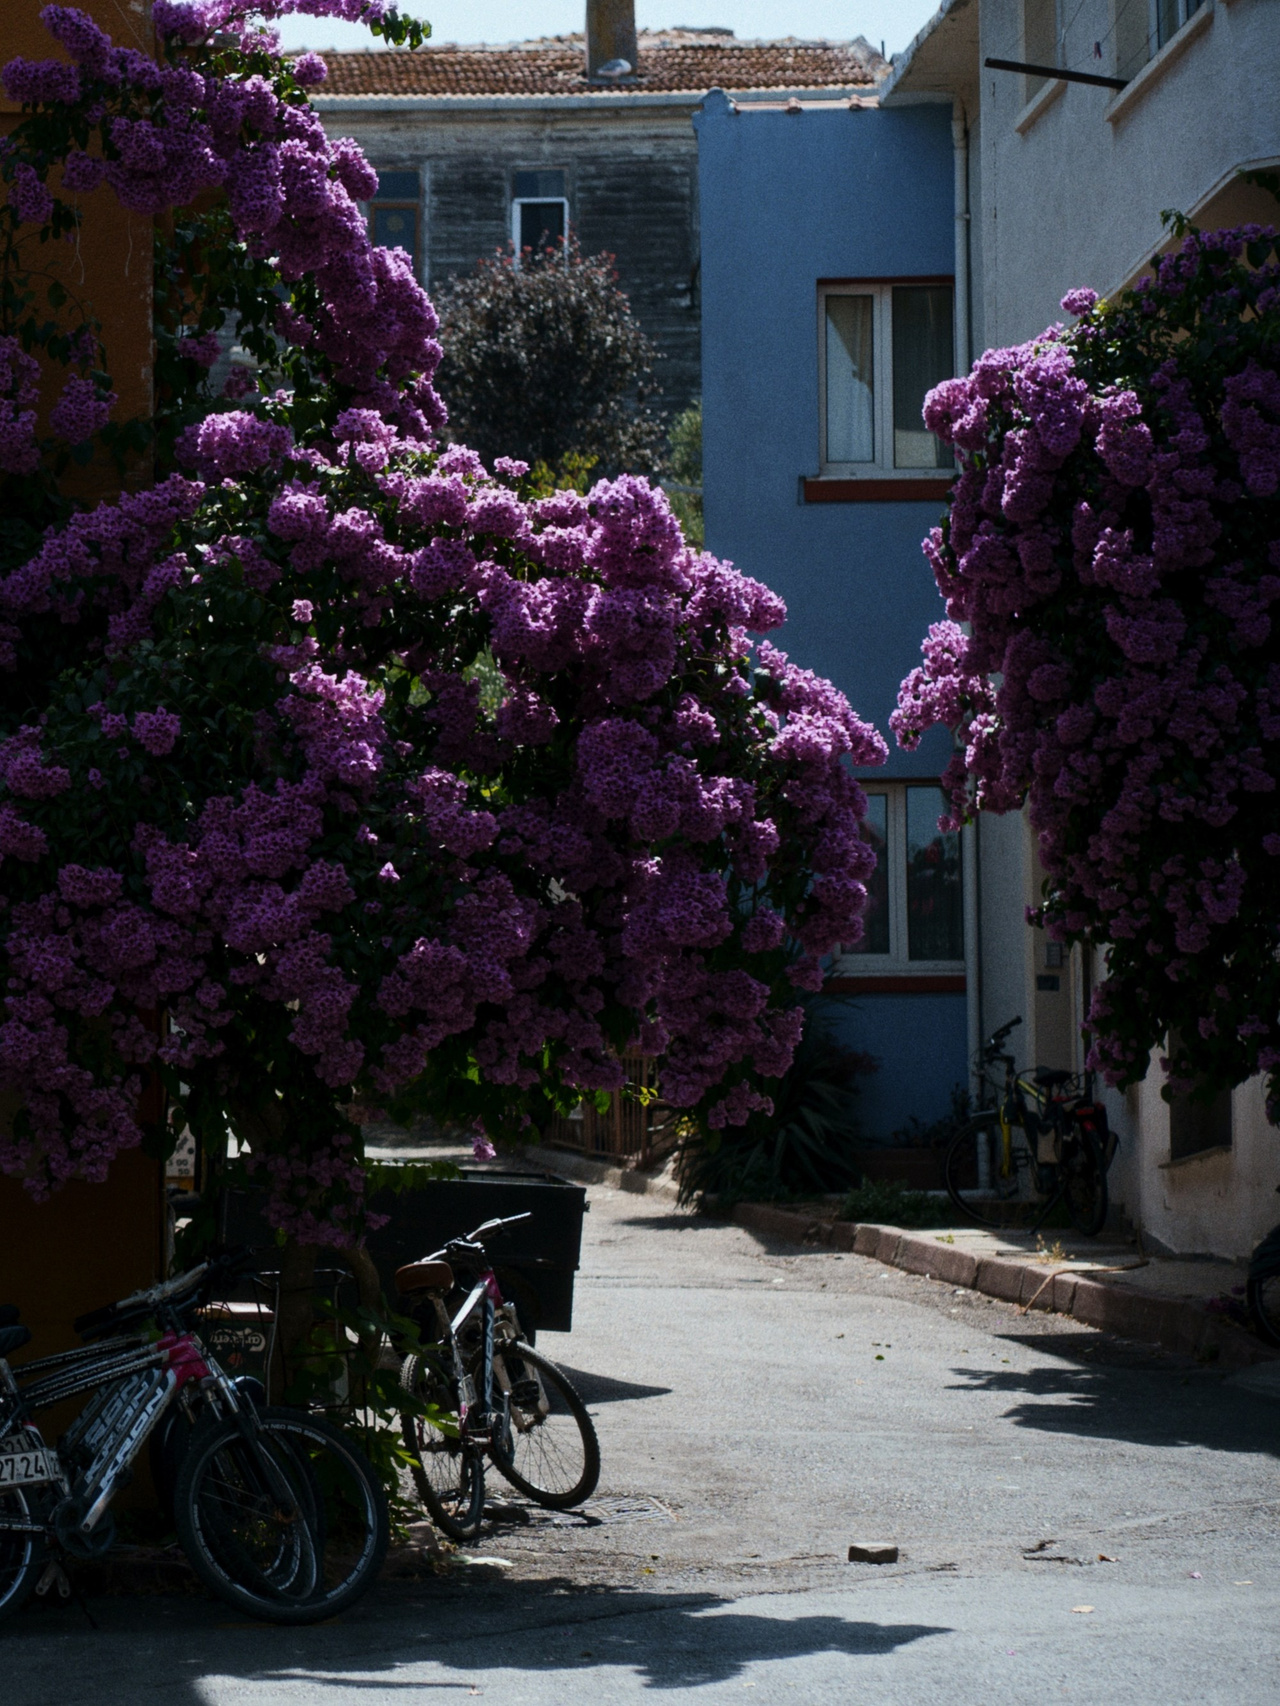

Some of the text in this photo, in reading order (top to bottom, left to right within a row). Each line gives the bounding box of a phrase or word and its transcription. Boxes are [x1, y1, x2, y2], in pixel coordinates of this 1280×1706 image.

[21, 1456, 45, 1478] 24
[84, 1381, 150, 1484] KRON
[99, 1386, 164, 1490] KRON
